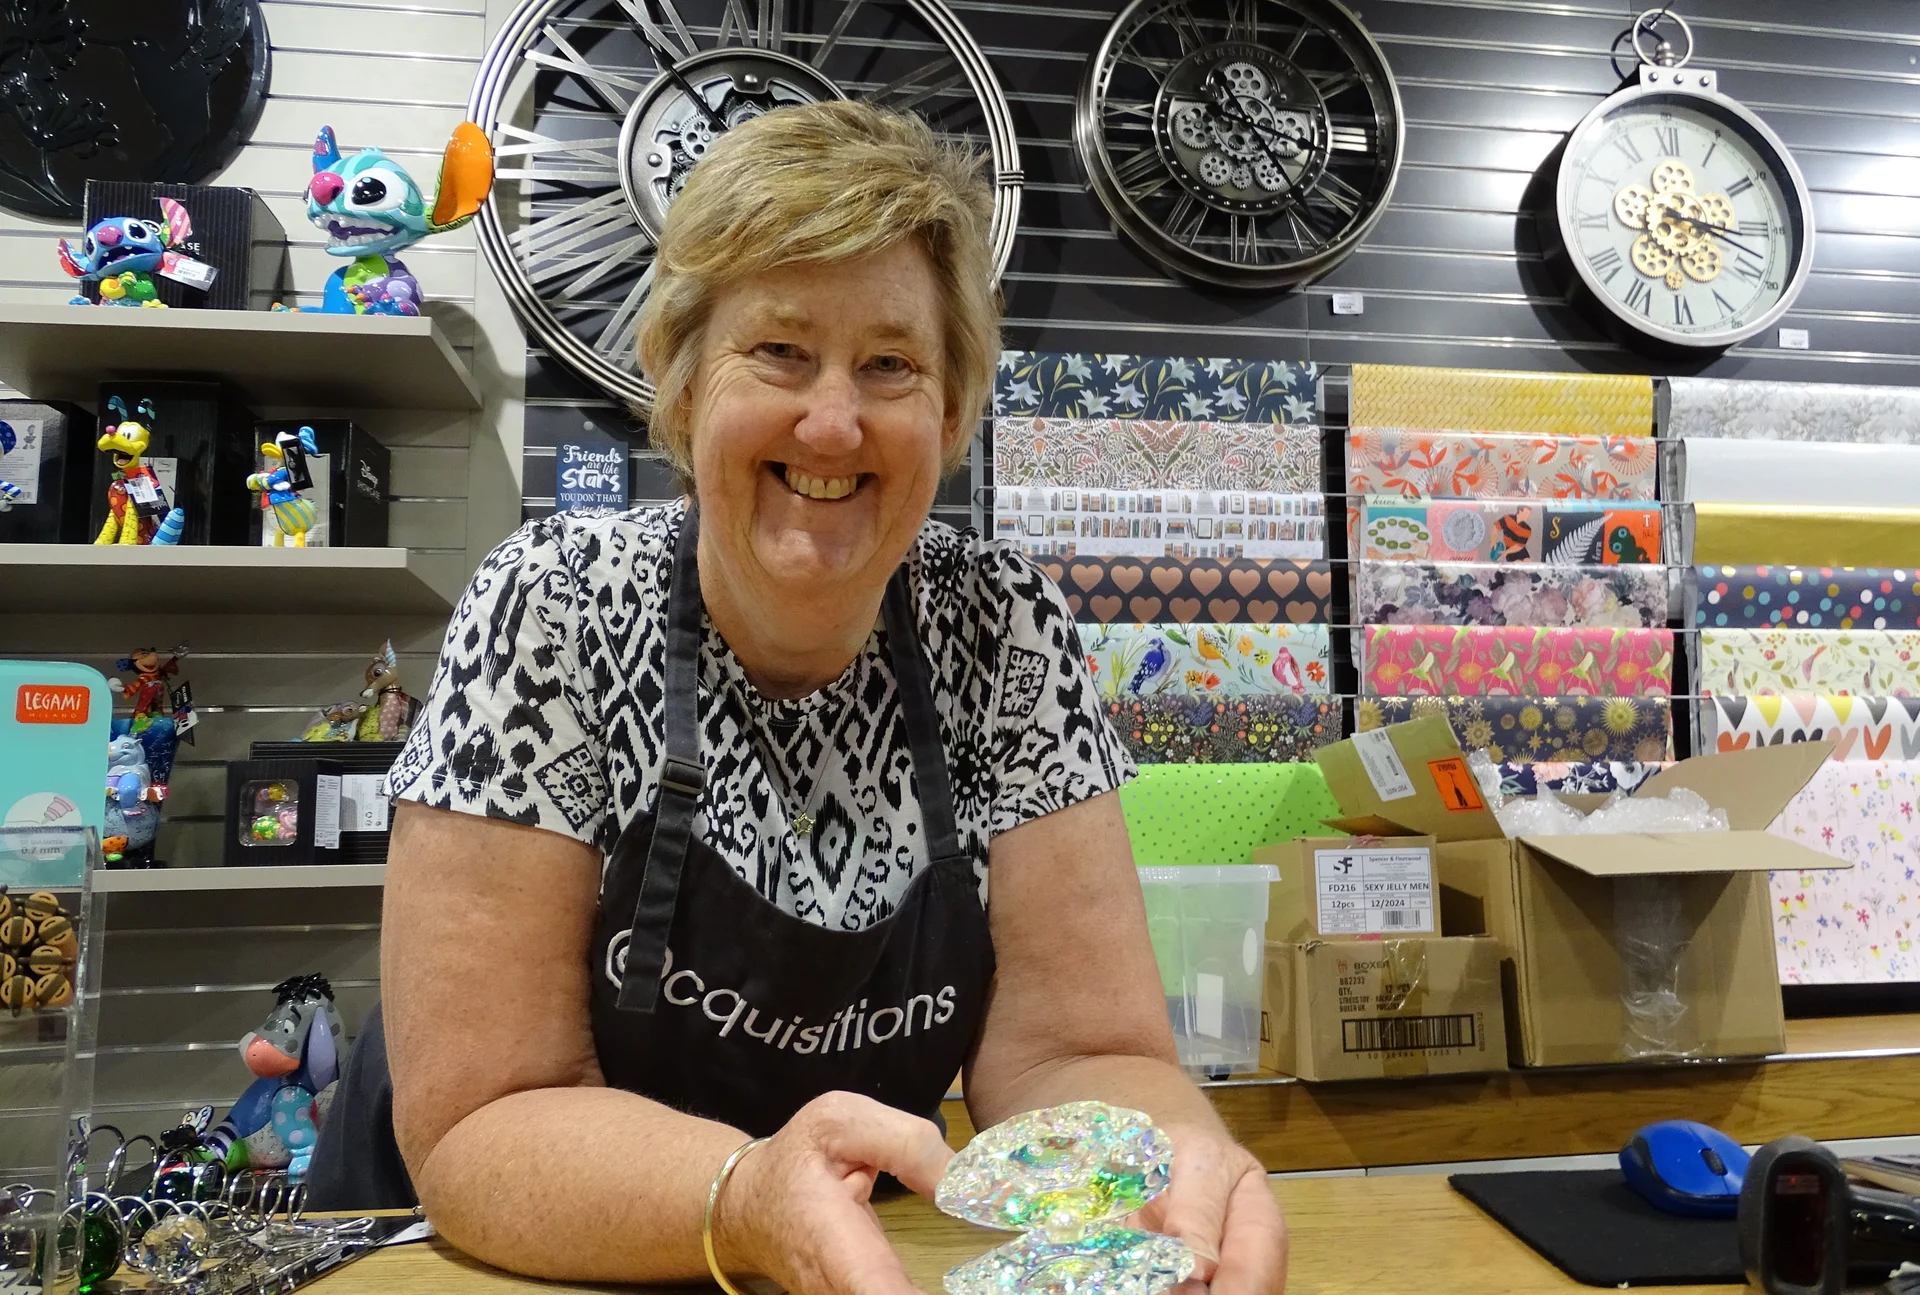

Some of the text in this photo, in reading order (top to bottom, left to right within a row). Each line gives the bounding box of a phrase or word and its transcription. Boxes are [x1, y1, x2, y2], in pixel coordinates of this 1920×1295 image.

[1194, 46, 1296, 77] KENSINGTON
[562, 444, 624, 464] Friends
[586, 461, 619, 475] are like
[561, 465, 621, 493] Stars
[560, 492, 577, 502] YOU
[602, 493, 623, 503] HAVE
[1372, 495, 1397, 506] kiwi
[1549, 516, 1561, 539] S
[1369, 855, 1389, 863] Spencer
[1328, 883, 1357, 893] FD216
[1364, 882, 1430, 892] SEXY JELLY MEN
[1331, 900, 1356, 910] 12pcs
[1371, 899, 1406, 909] 12/2024
